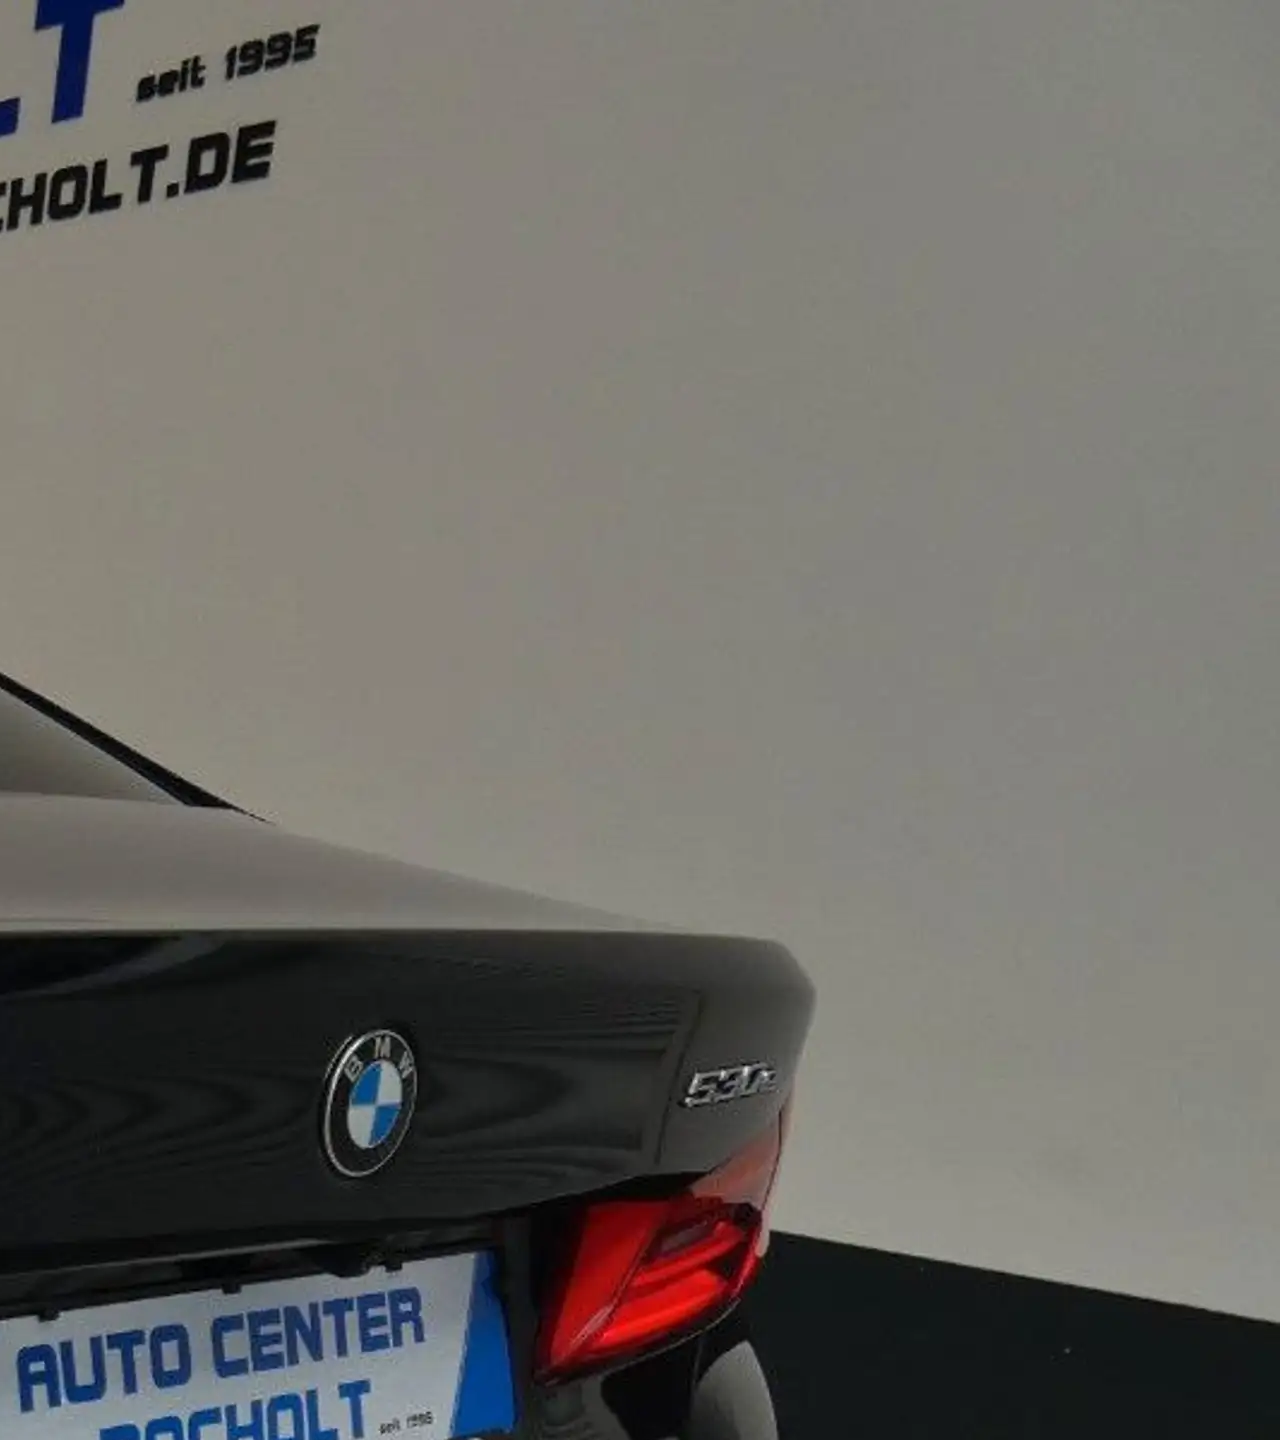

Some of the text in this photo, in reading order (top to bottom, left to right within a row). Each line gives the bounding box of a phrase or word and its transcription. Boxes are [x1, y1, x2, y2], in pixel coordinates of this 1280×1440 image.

[135, 54, 207, 104] seit
[224, 23, 321, 82] 1995
[343, 1035, 415, 1083] BMW
[16, 1287, 427, 1412] AUTO CENTER
